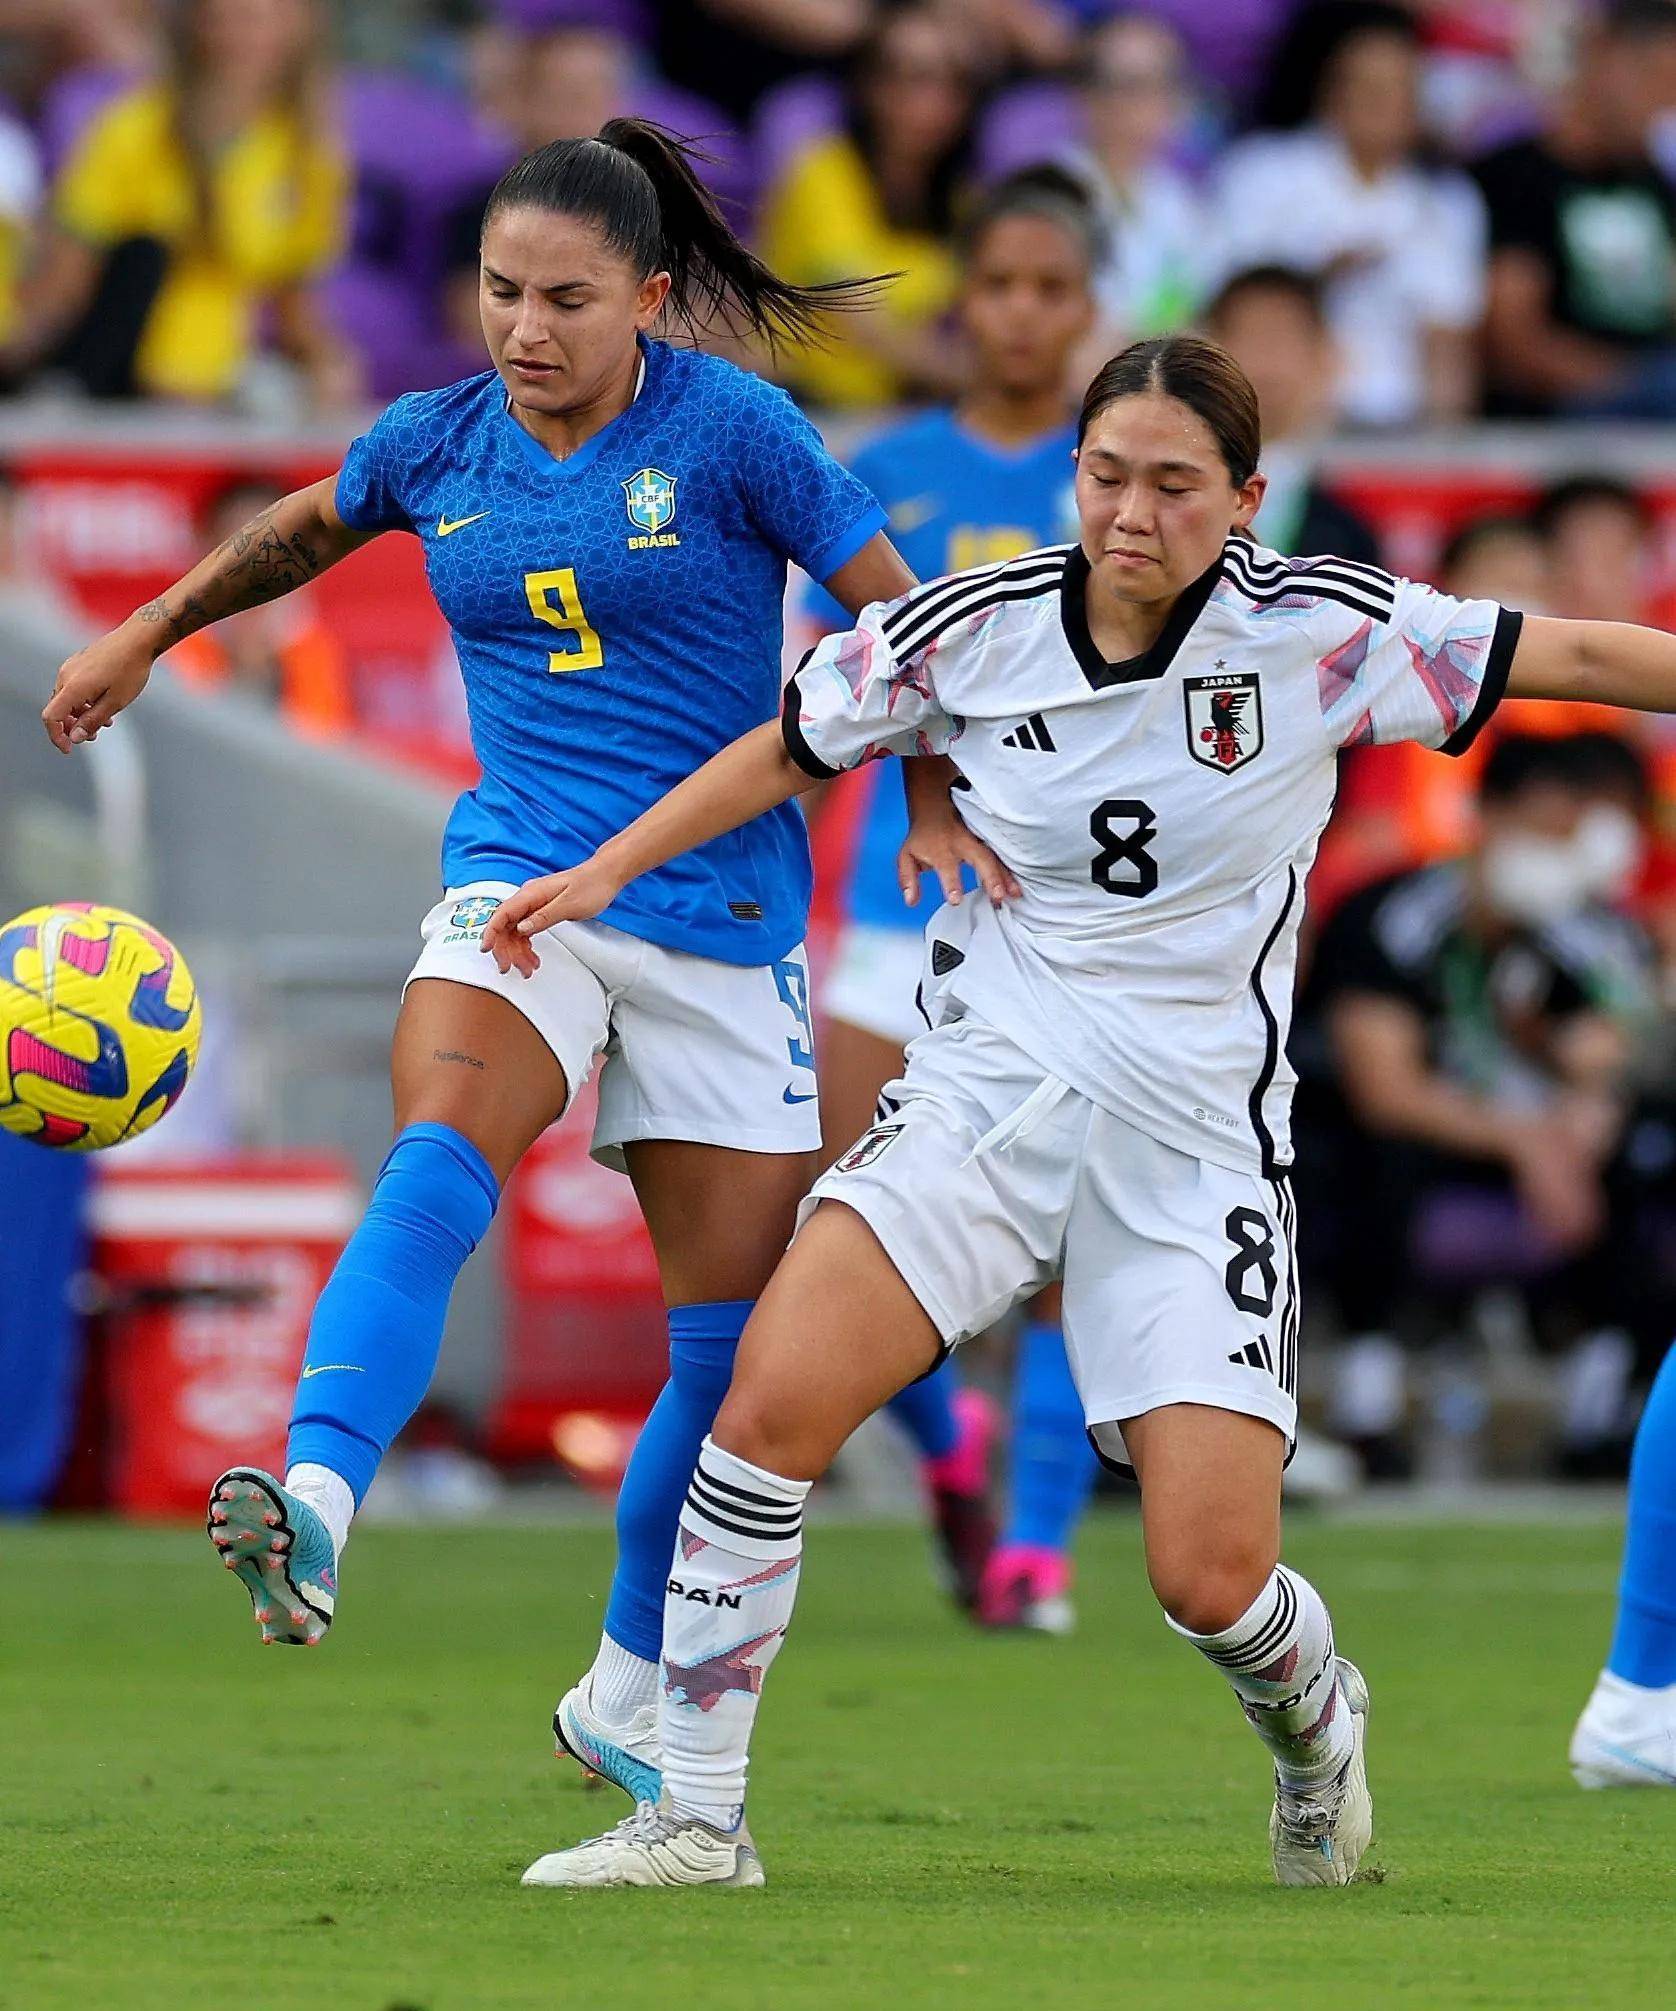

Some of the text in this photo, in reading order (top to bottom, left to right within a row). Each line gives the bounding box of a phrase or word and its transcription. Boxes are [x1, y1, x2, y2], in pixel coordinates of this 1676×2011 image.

[627, 534, 680, 550] BRASIL
[641, 495, 660, 503] CBF
[524, 568, 604, 674] 9
[1200, 677, 1243, 687] JAPAN
[1090, 799, 1158, 899] 8
[771, 960, 814, 1072] 9
[1225, 1205, 1278, 1319] 8
